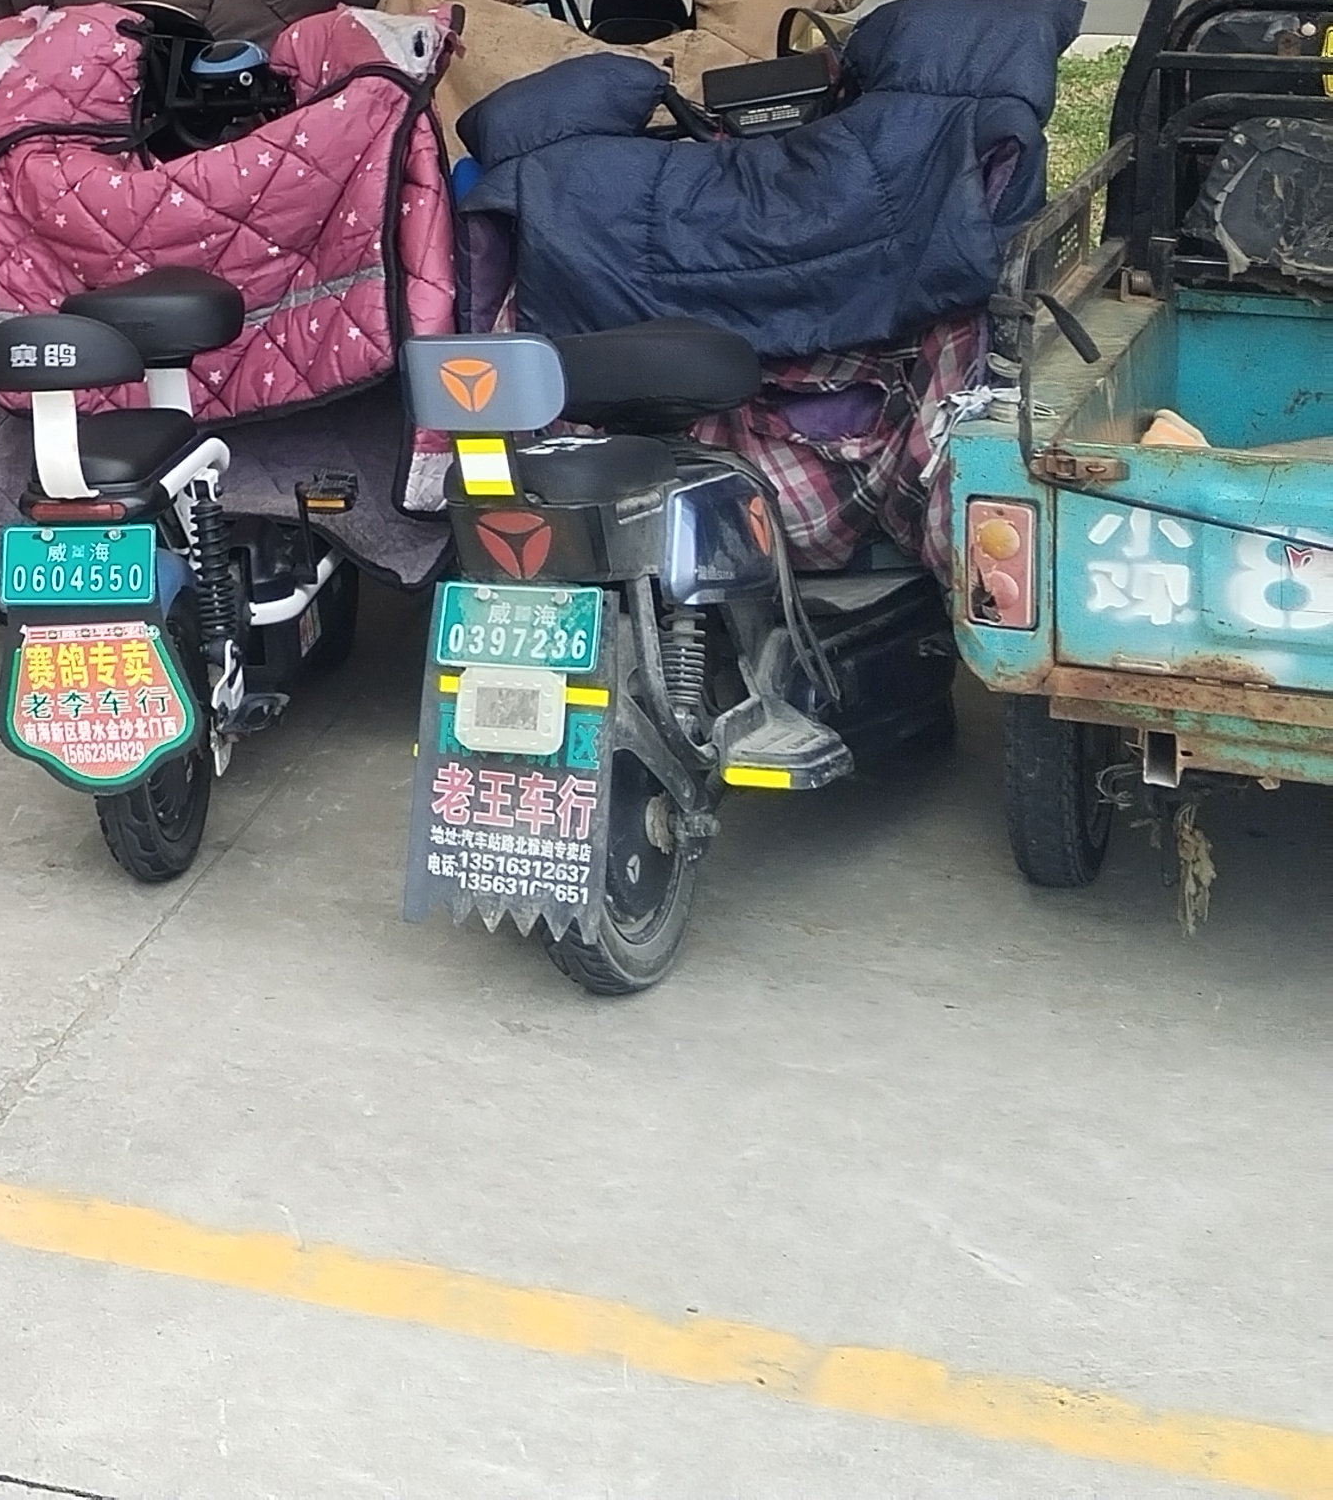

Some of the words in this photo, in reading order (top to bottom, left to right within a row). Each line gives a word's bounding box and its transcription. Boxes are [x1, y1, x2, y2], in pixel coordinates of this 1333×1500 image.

[12, 564, 143, 592] 0604550
[448, 623, 588, 660] 0397236
[25, 639, 154, 689] 赛鸽专卖
[21, 686, 172, 720] 老李车行
[431, 762, 597, 840] 老王车行
[458, 851, 591, 884] 13516312637
